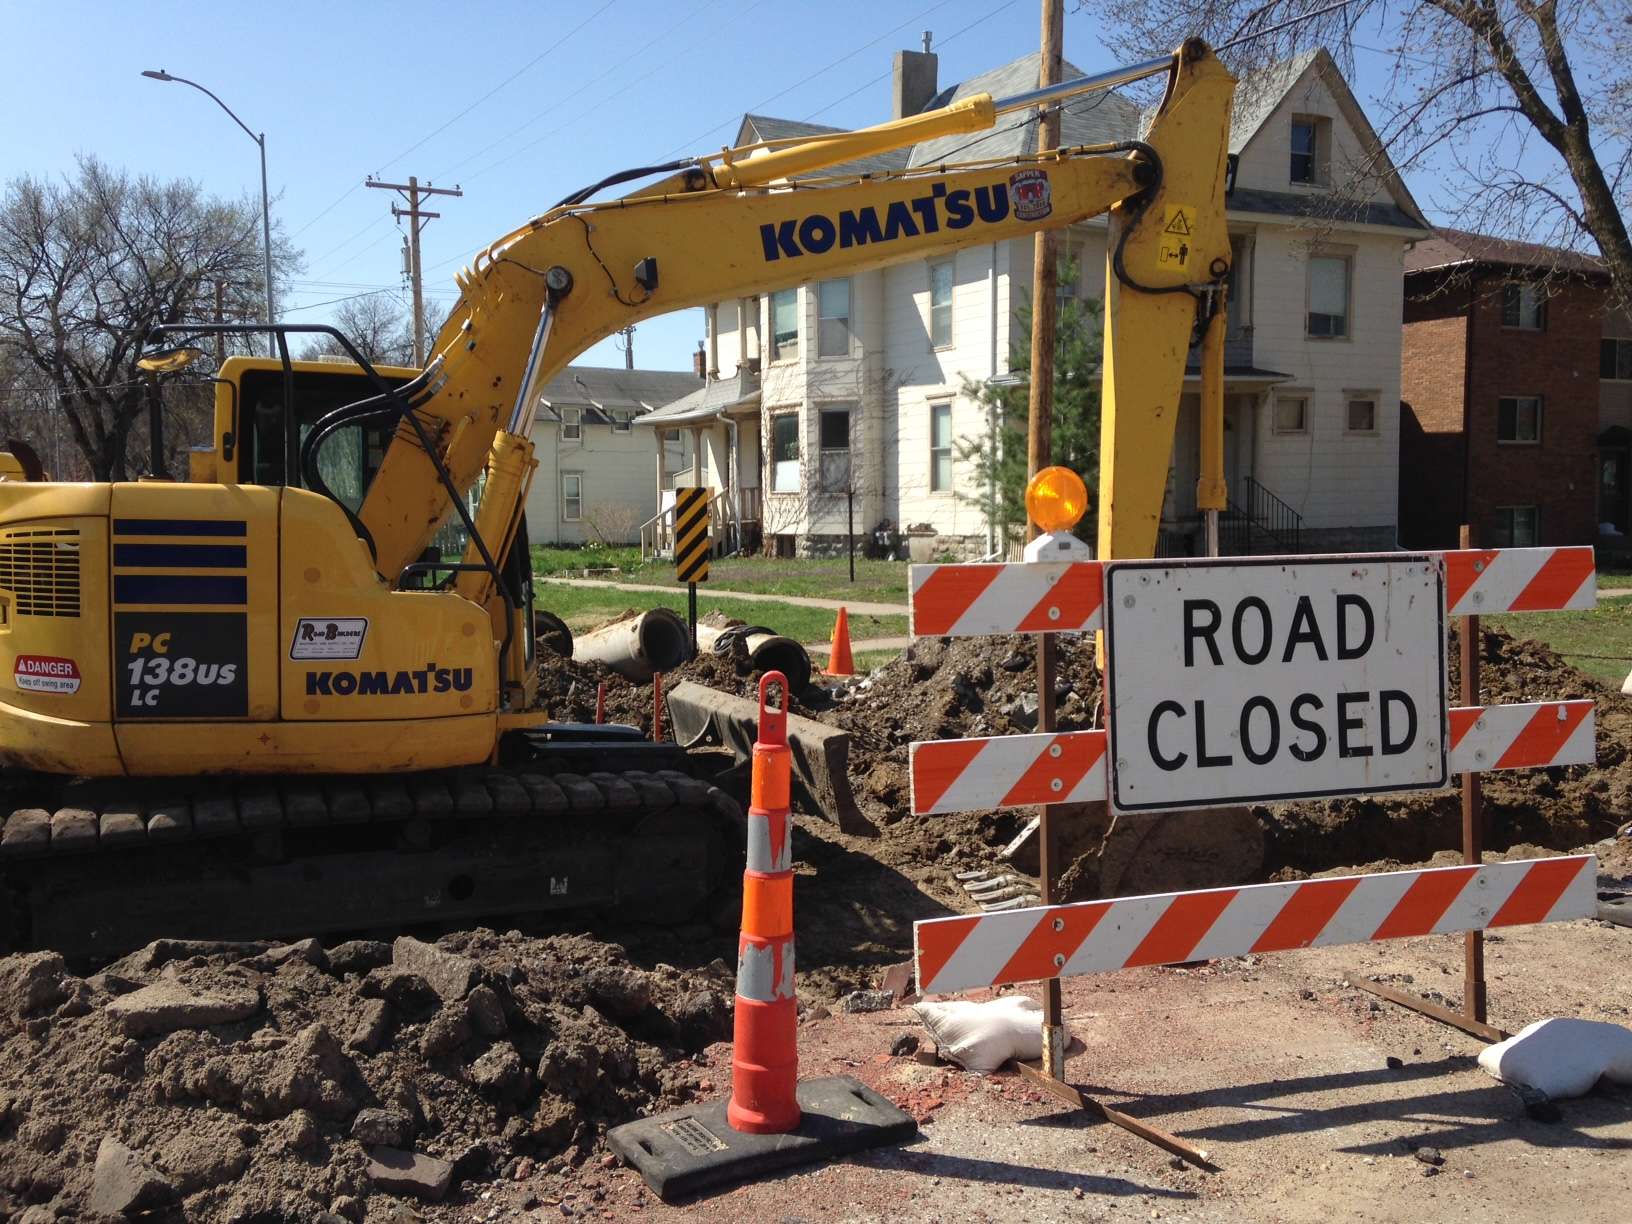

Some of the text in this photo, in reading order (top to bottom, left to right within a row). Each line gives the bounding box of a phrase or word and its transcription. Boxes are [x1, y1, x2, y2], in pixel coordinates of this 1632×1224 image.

[760, 183, 1010, 261] KOMATSU
[130, 632, 171, 654] PC
[1183, 594, 1375, 667] ROAD
[27, 661, 73, 675] DANGER
[306, 663, 473, 695] KOMATSU
[18, 677, 74, 689] Keep off swing area
[130, 688, 160, 706] LC
[1148, 690, 1418, 771] CLOSED
